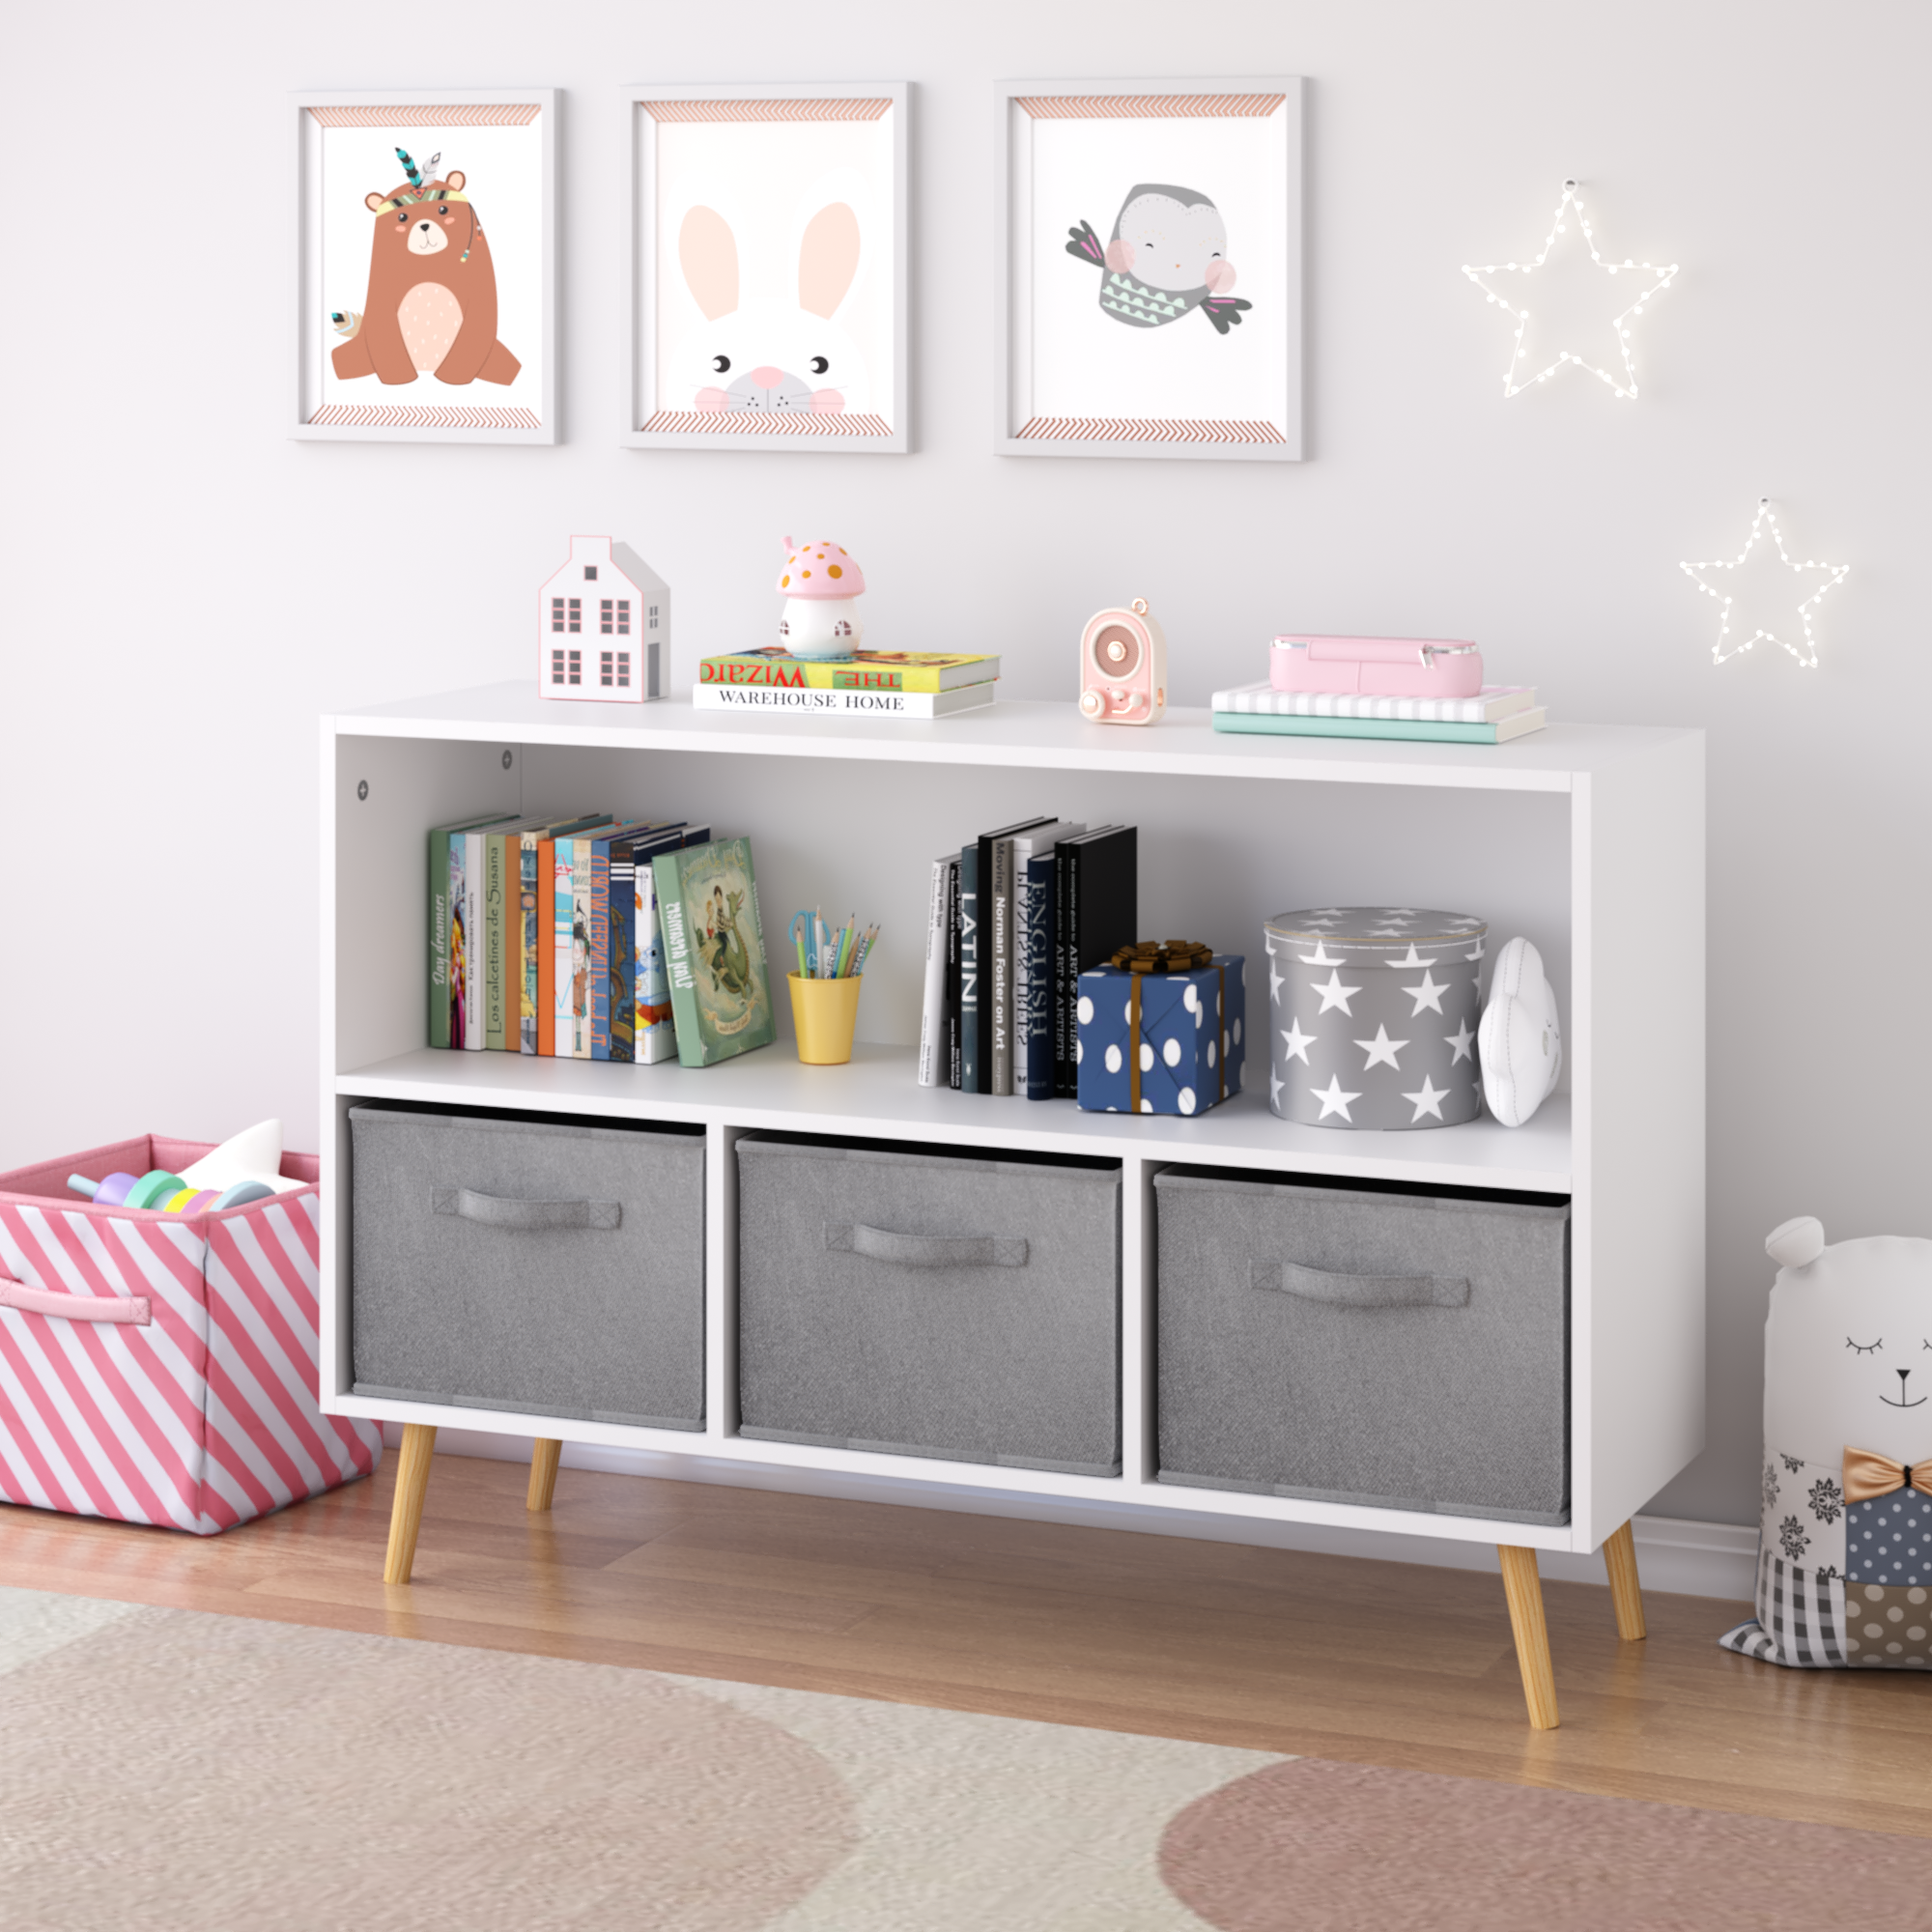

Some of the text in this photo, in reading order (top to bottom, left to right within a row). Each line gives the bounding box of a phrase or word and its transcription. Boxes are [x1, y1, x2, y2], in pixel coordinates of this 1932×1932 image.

[835, 670, 902, 688] THE
[720, 690, 904, 711] WAREHOUSE HOME
[938, 865, 947, 897] Designing
[431, 894, 450, 985] Day dreamers
[486, 847, 501, 1035] Los calcetines de Susana
[961, 893, 978, 1002] LATIN
[994, 842, 1006, 1050] Moving Norman Foster on Art
[1057, 932, 1063, 941] to
[1031, 880, 1048, 1037] ENGLISH
[1056, 944, 1065, 977] ART
[1069, 945, 1078, 977] ART
[1056, 979, 1065, 993] &
[1069, 980, 1078, 993] &
[1056, 995, 1065, 1062] ARTISTS
[1069, 995, 1078, 1063] ARTISTS
